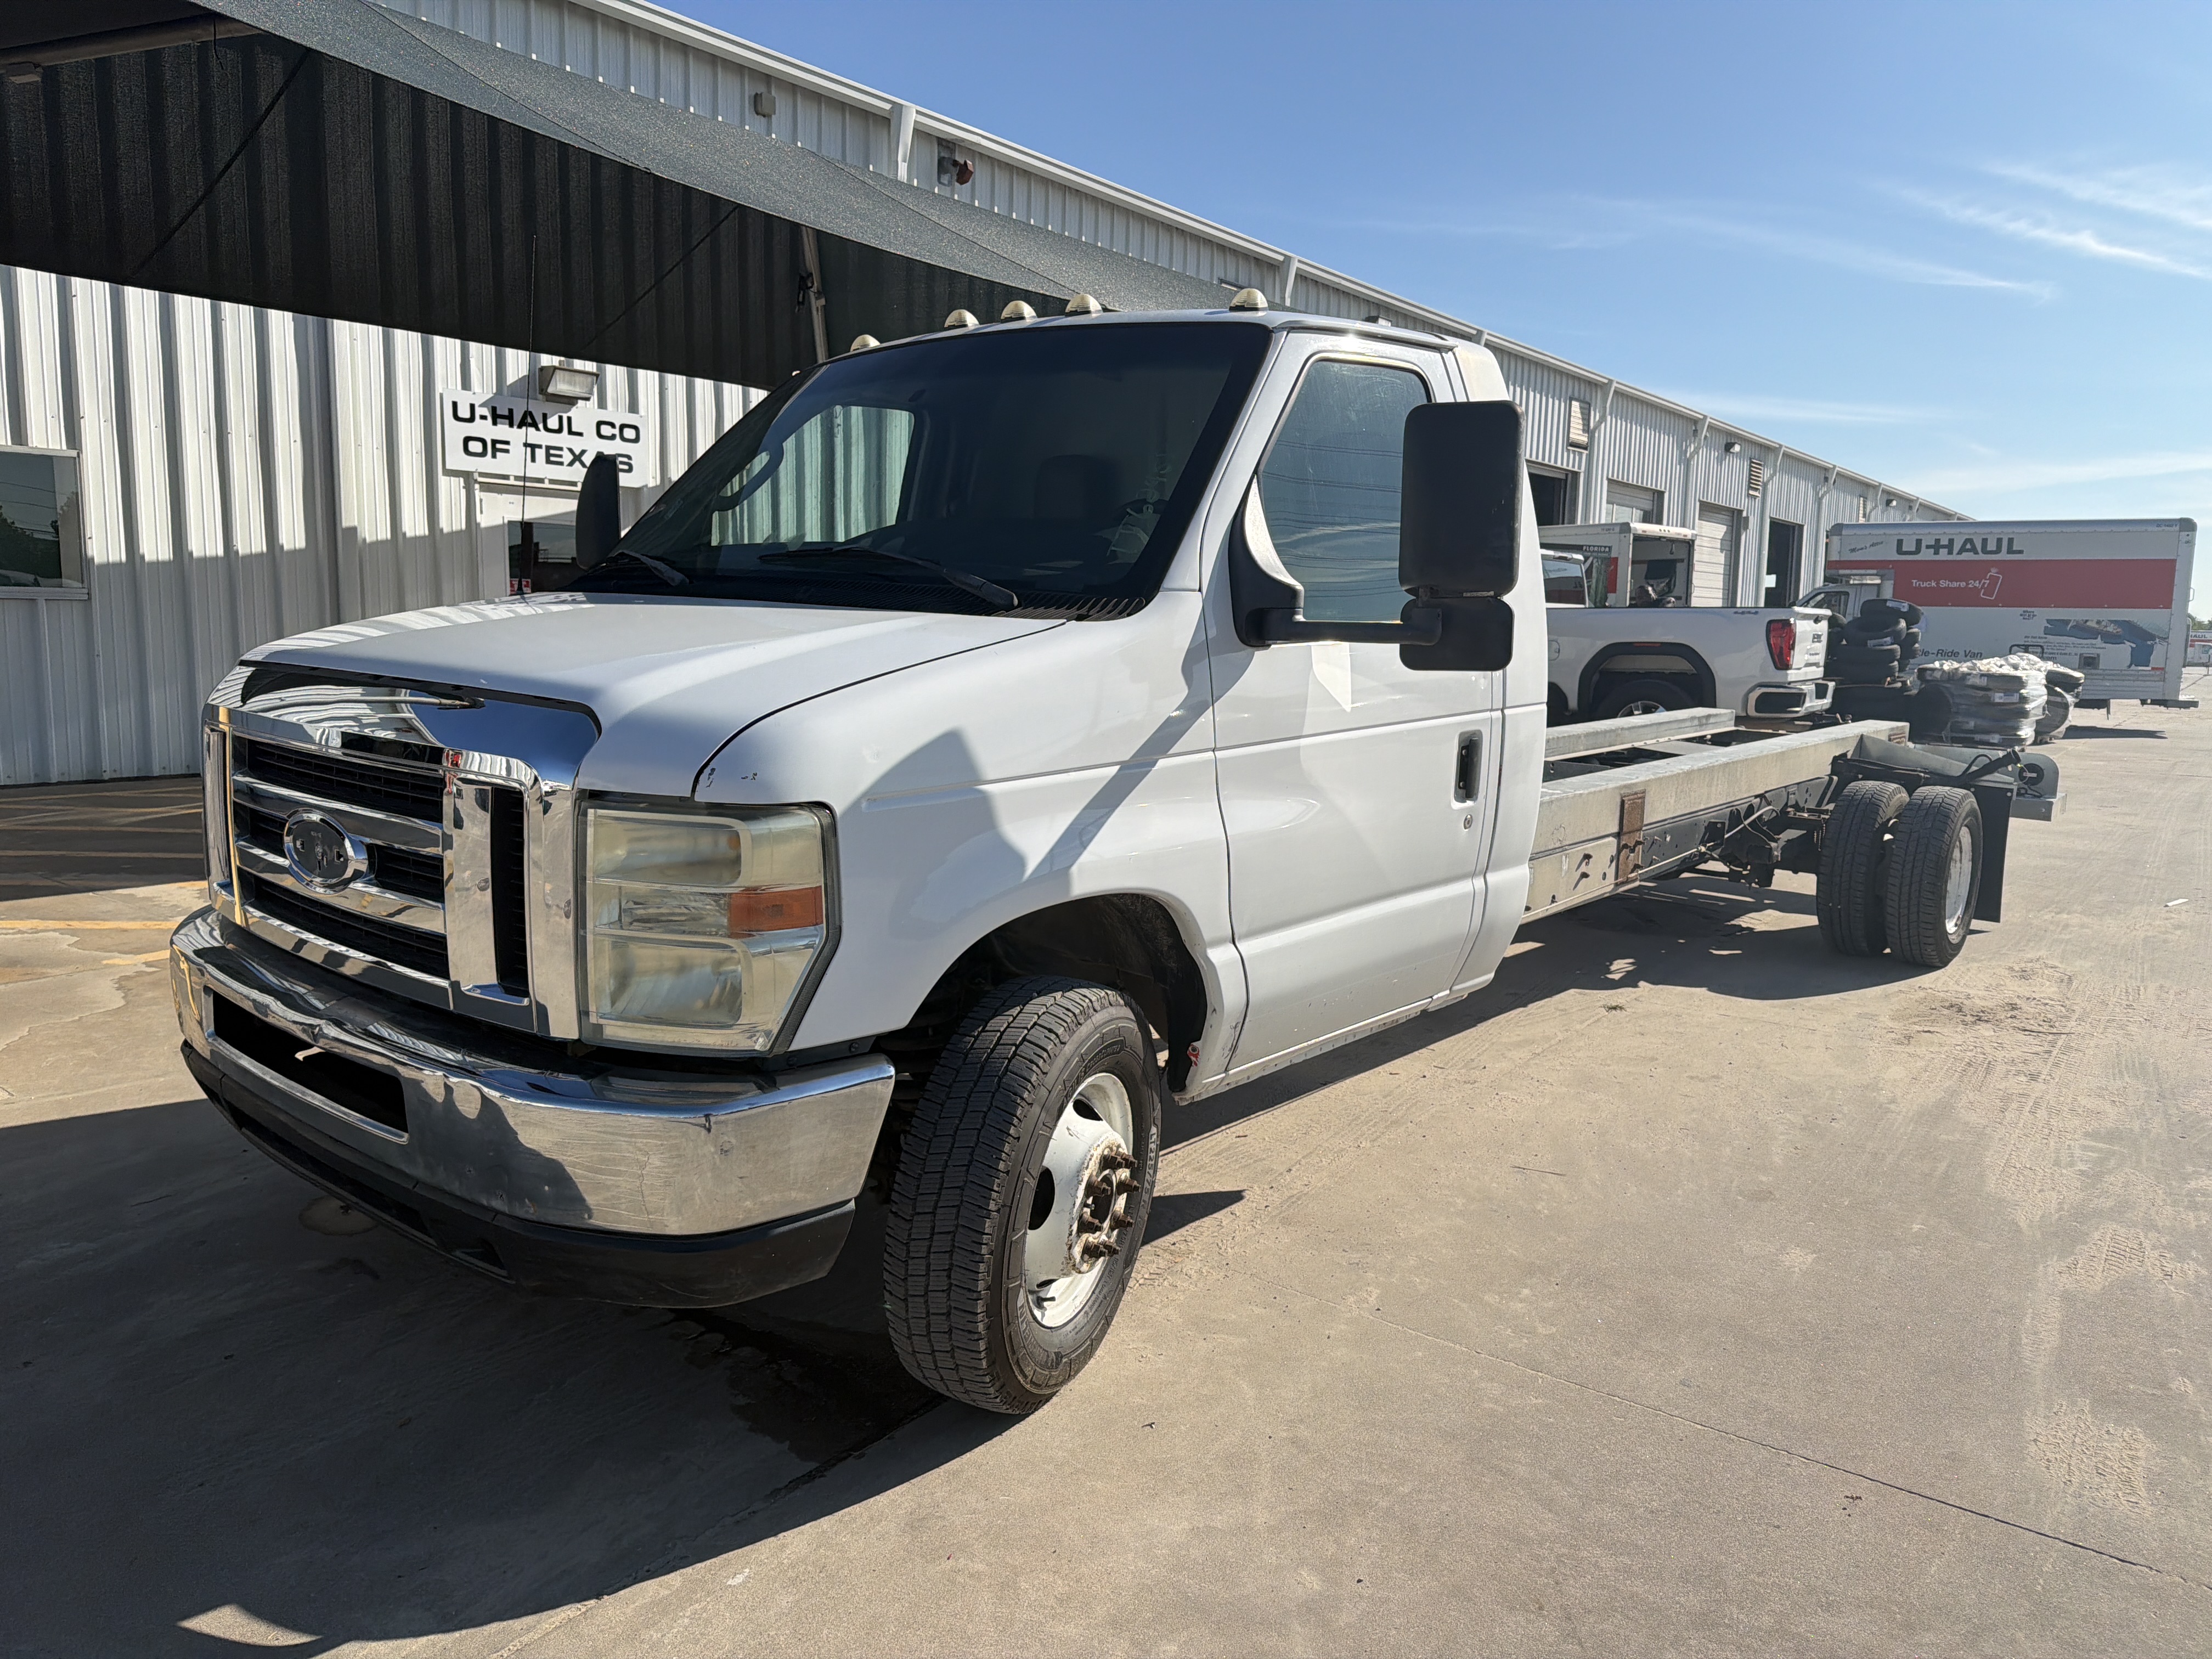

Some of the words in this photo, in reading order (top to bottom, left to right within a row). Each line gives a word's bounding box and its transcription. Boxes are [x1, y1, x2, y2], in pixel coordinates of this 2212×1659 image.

[452, 401, 583, 437] U-HAUL
[596, 420, 640, 444] CO
[462, 436, 510, 459] OF
[523, 442, 633, 473] TEXS
[1897, 538, 2024, 555] U-HAUL
[1968, 579, 1989, 589] 24/7
[1919, 648, 1960, 657] le-Ride
[1964, 650, 1983, 658] Van
